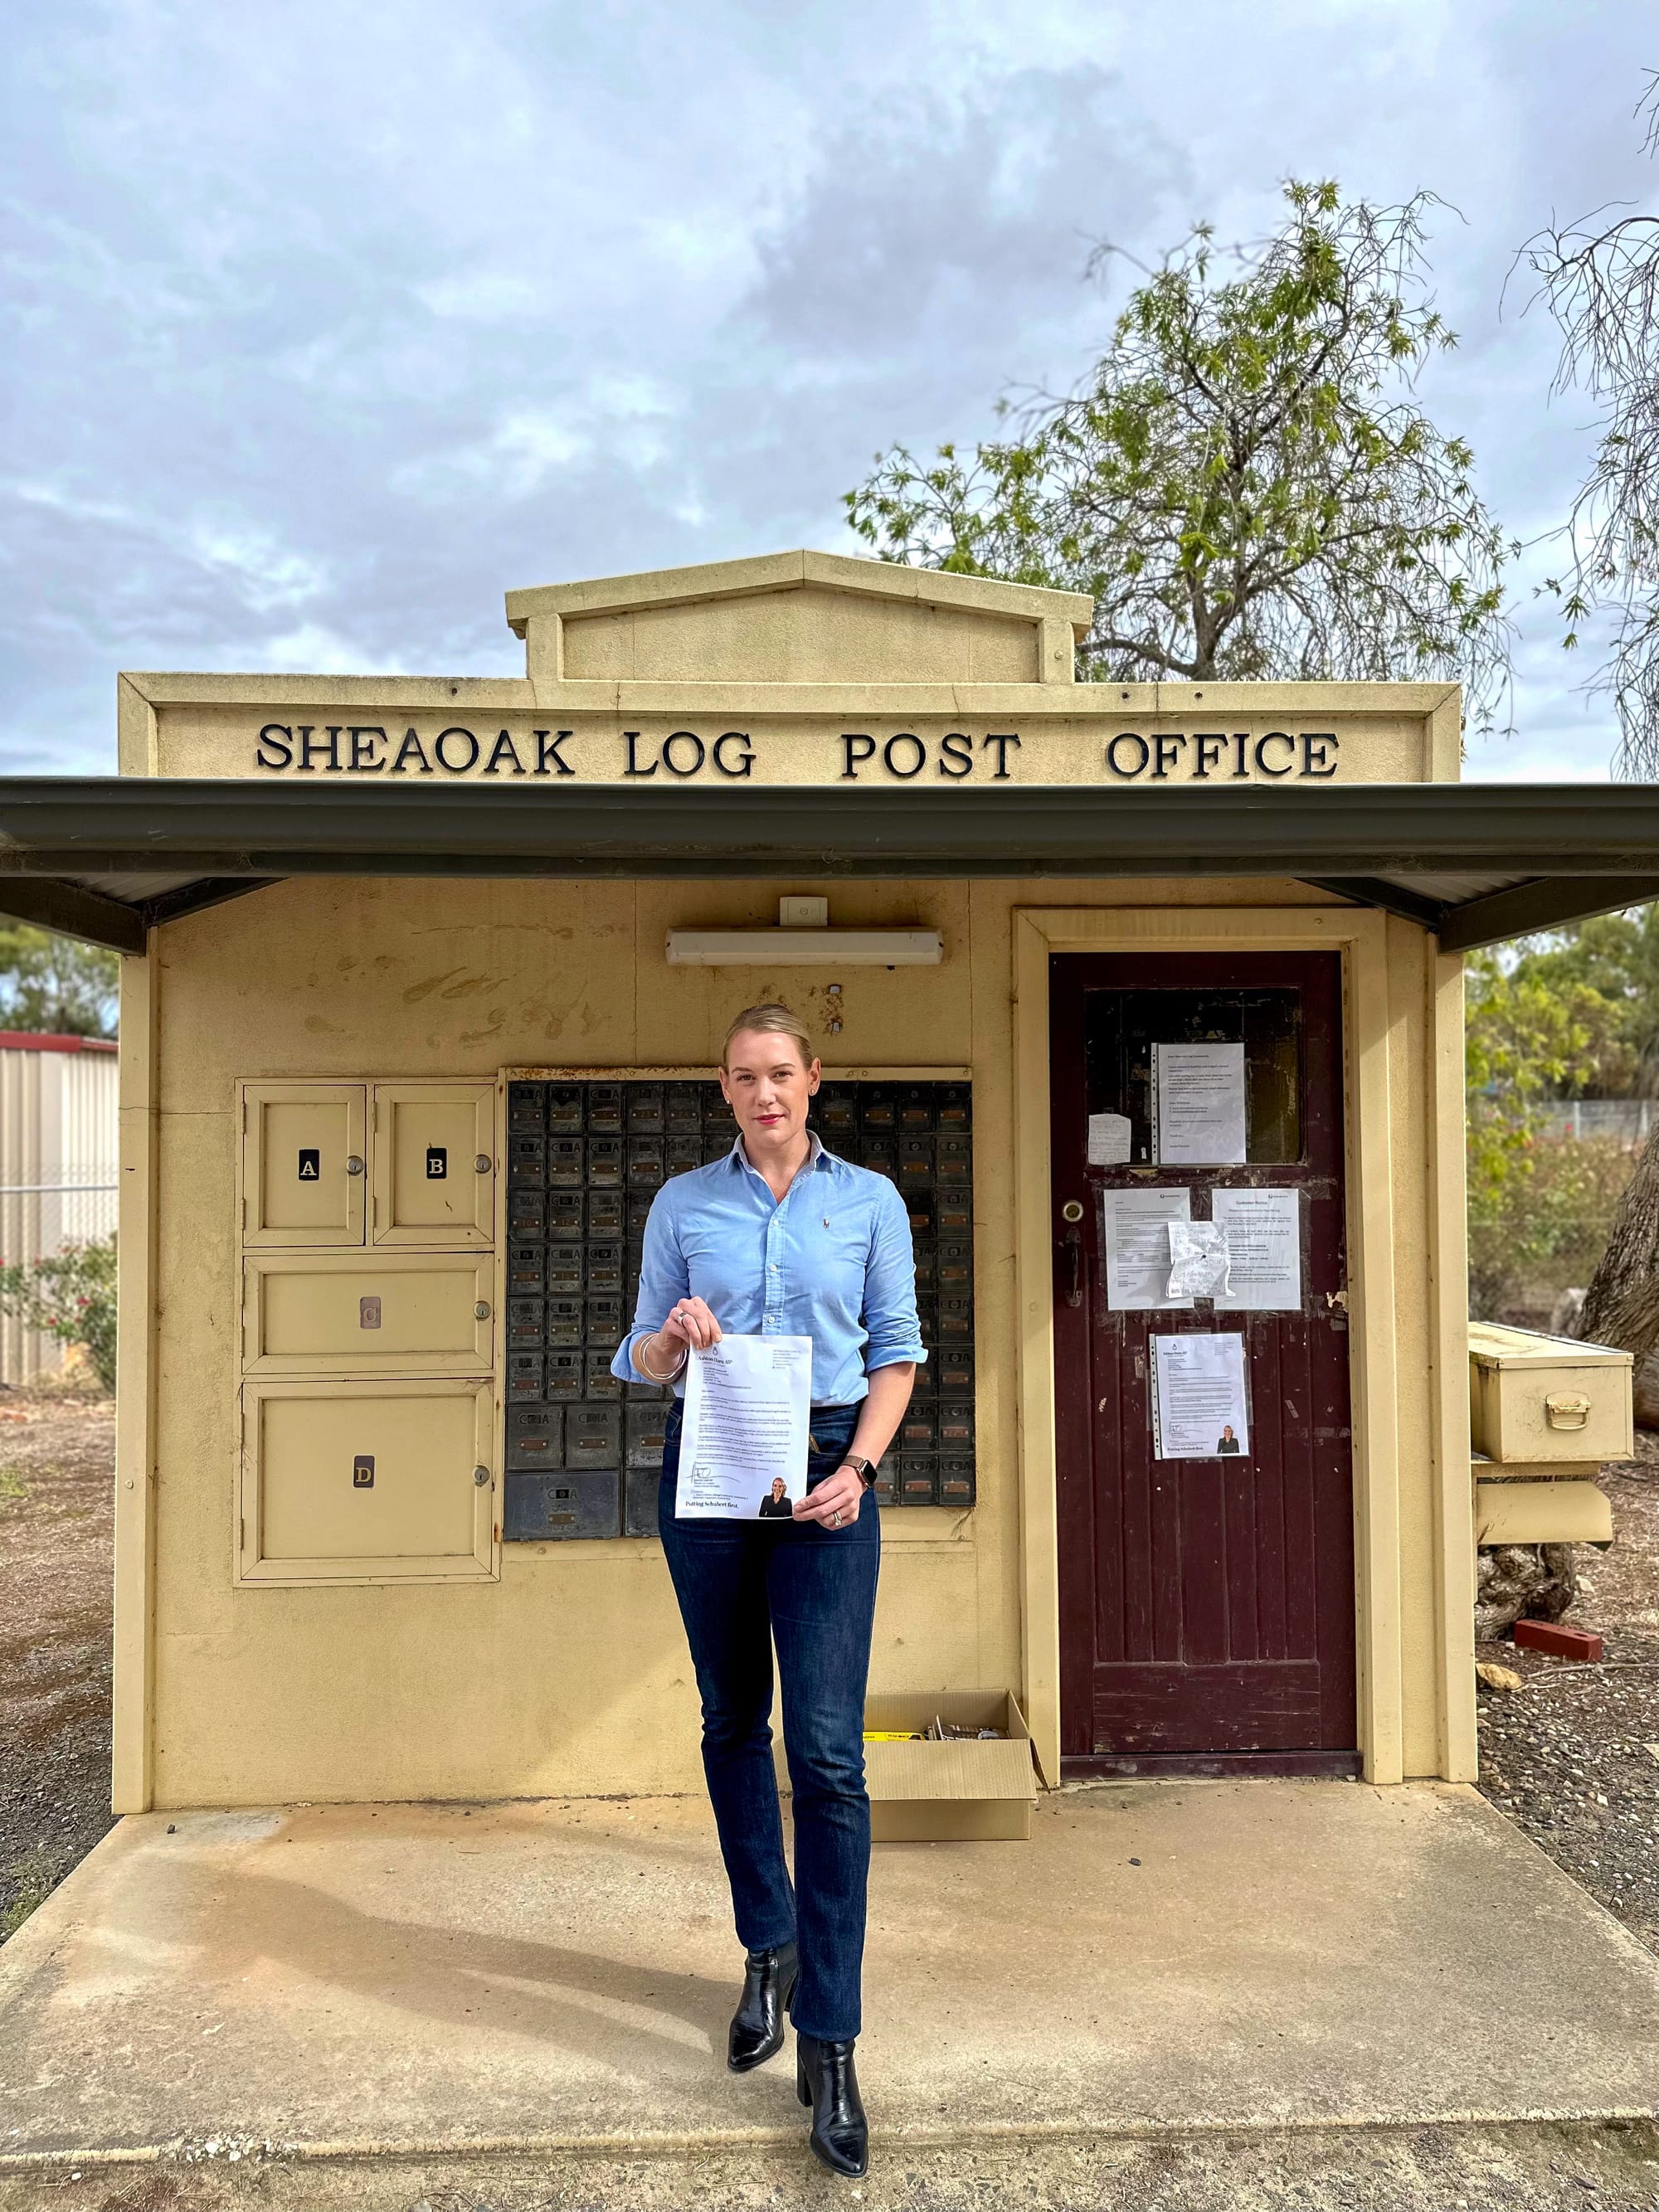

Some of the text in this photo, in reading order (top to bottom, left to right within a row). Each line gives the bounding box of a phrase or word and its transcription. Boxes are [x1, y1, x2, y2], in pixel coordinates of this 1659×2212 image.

[257, 723, 1340, 779] SHEAOAK LOG POST OFFICE
[299, 1160, 318, 1176] A
[428, 1159, 444, 1174] B
[355, 1467, 372, 1483] D
[547, 1490, 577, 1500] C A
